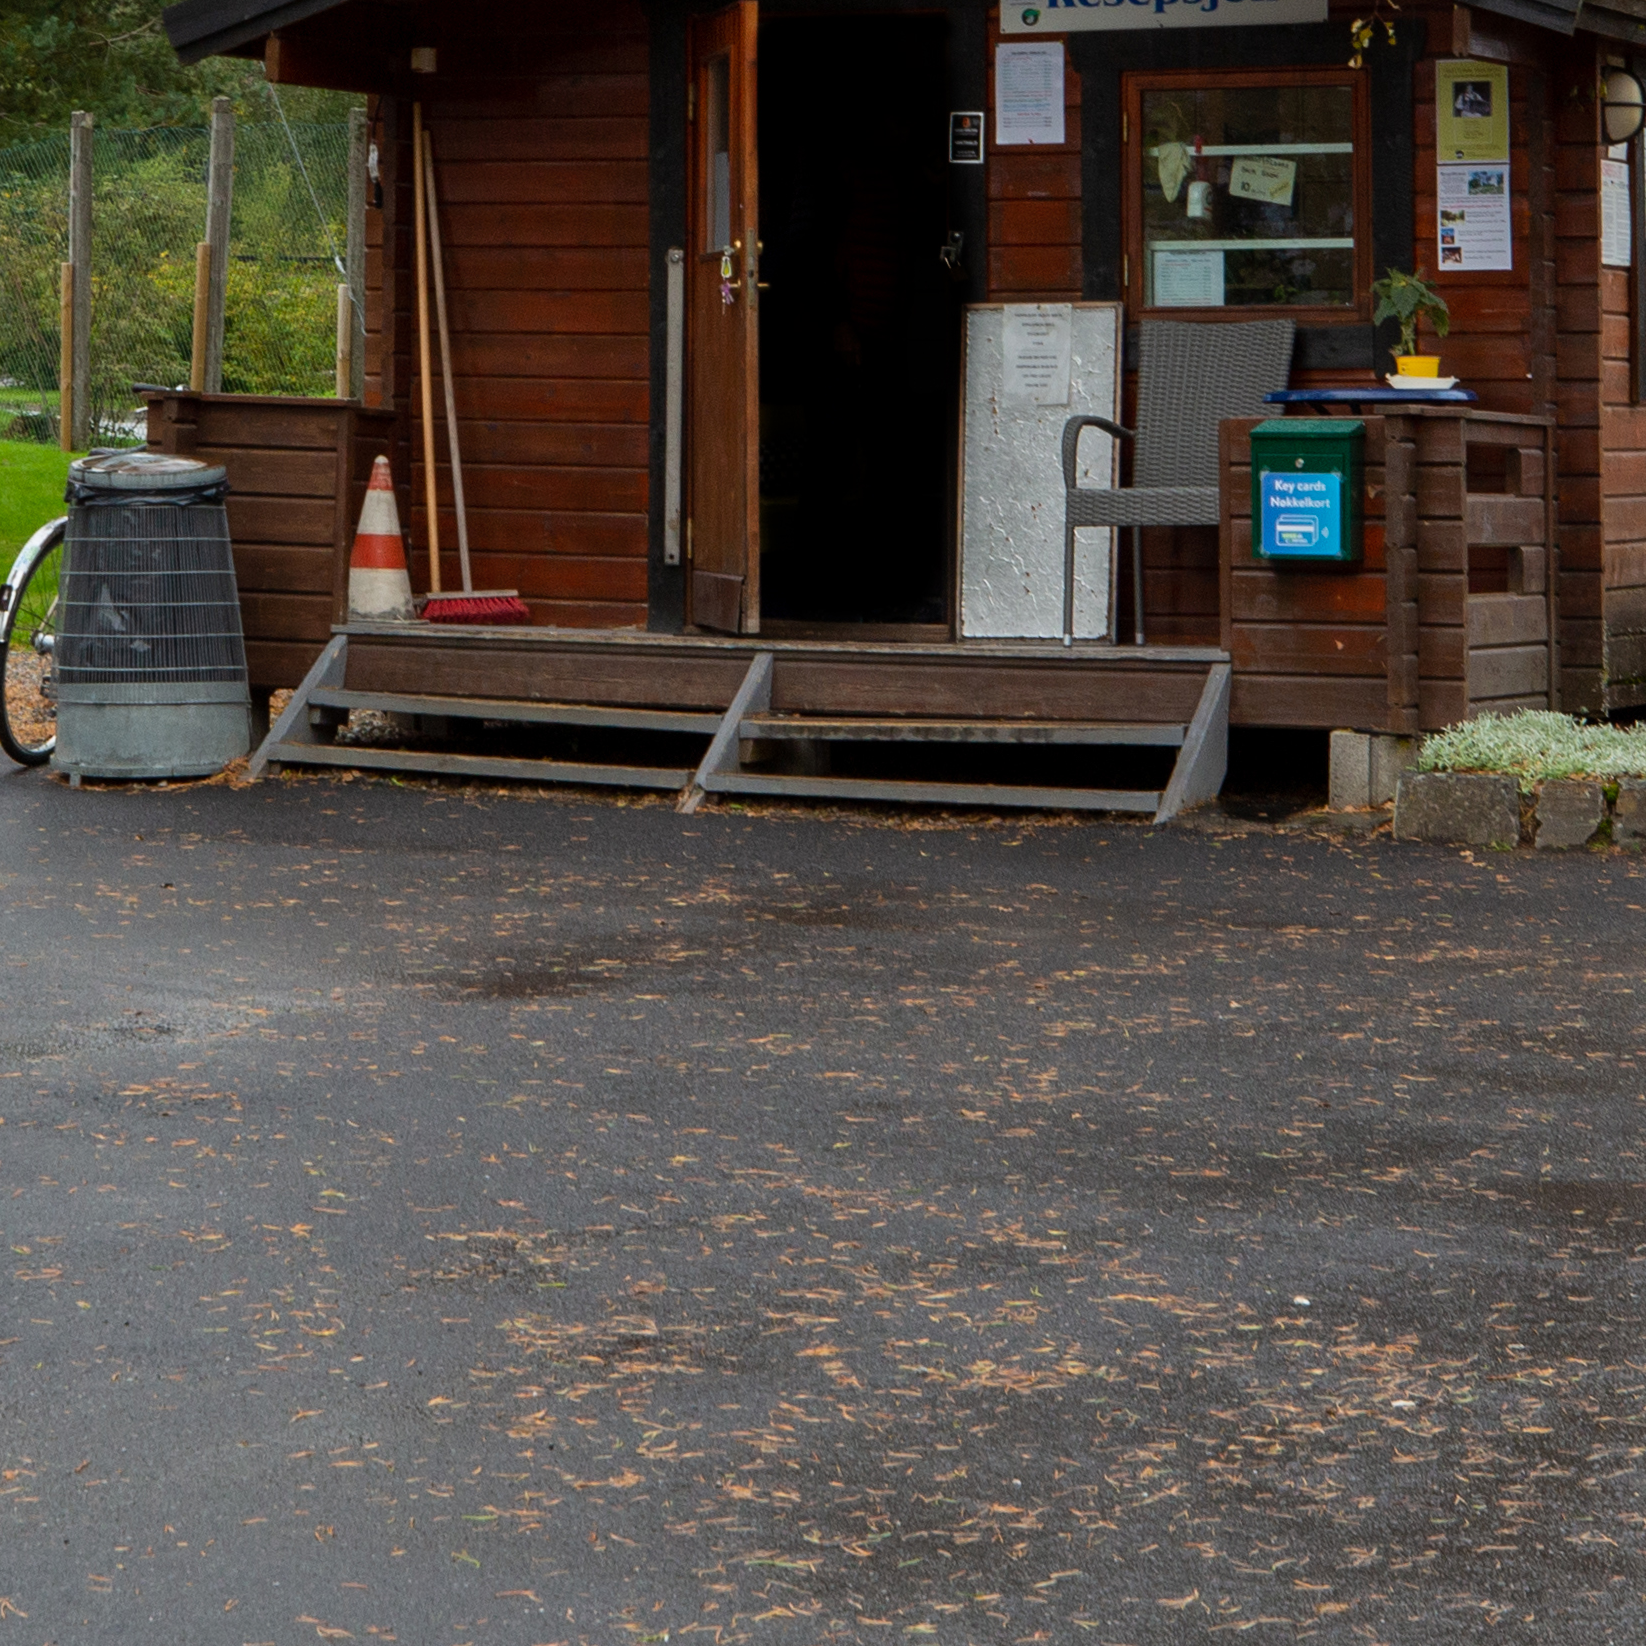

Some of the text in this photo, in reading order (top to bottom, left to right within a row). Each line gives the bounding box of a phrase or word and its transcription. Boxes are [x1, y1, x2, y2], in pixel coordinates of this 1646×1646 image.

[1274, 479, 1326, 494] Key cards
[1270, 496, 1331, 508] Nøkkelkort
